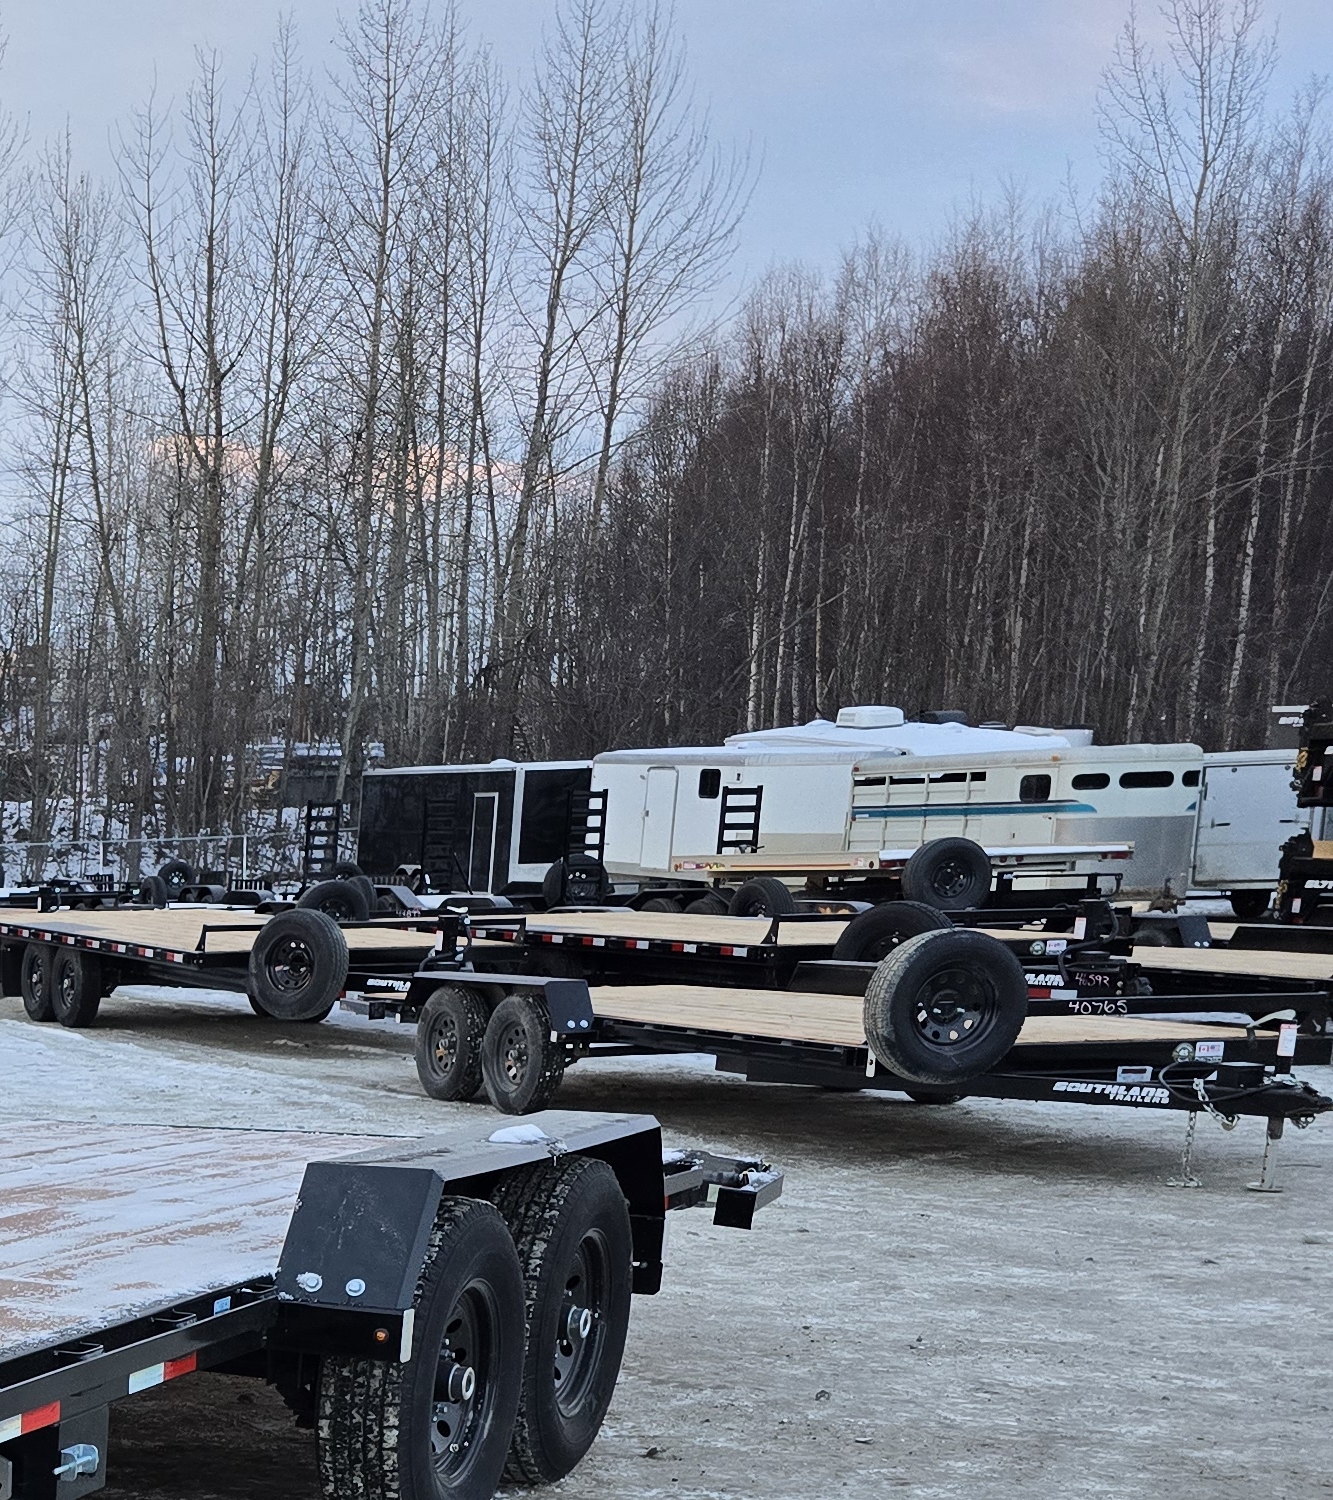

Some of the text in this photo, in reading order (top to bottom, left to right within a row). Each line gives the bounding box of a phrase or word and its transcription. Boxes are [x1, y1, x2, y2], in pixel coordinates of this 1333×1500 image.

[1068, 1000, 1128, 1014] 40765
[1053, 1081, 1170, 1098] SOUTHLAND
[1109, 1093, 1170, 1104] TRAILERS
